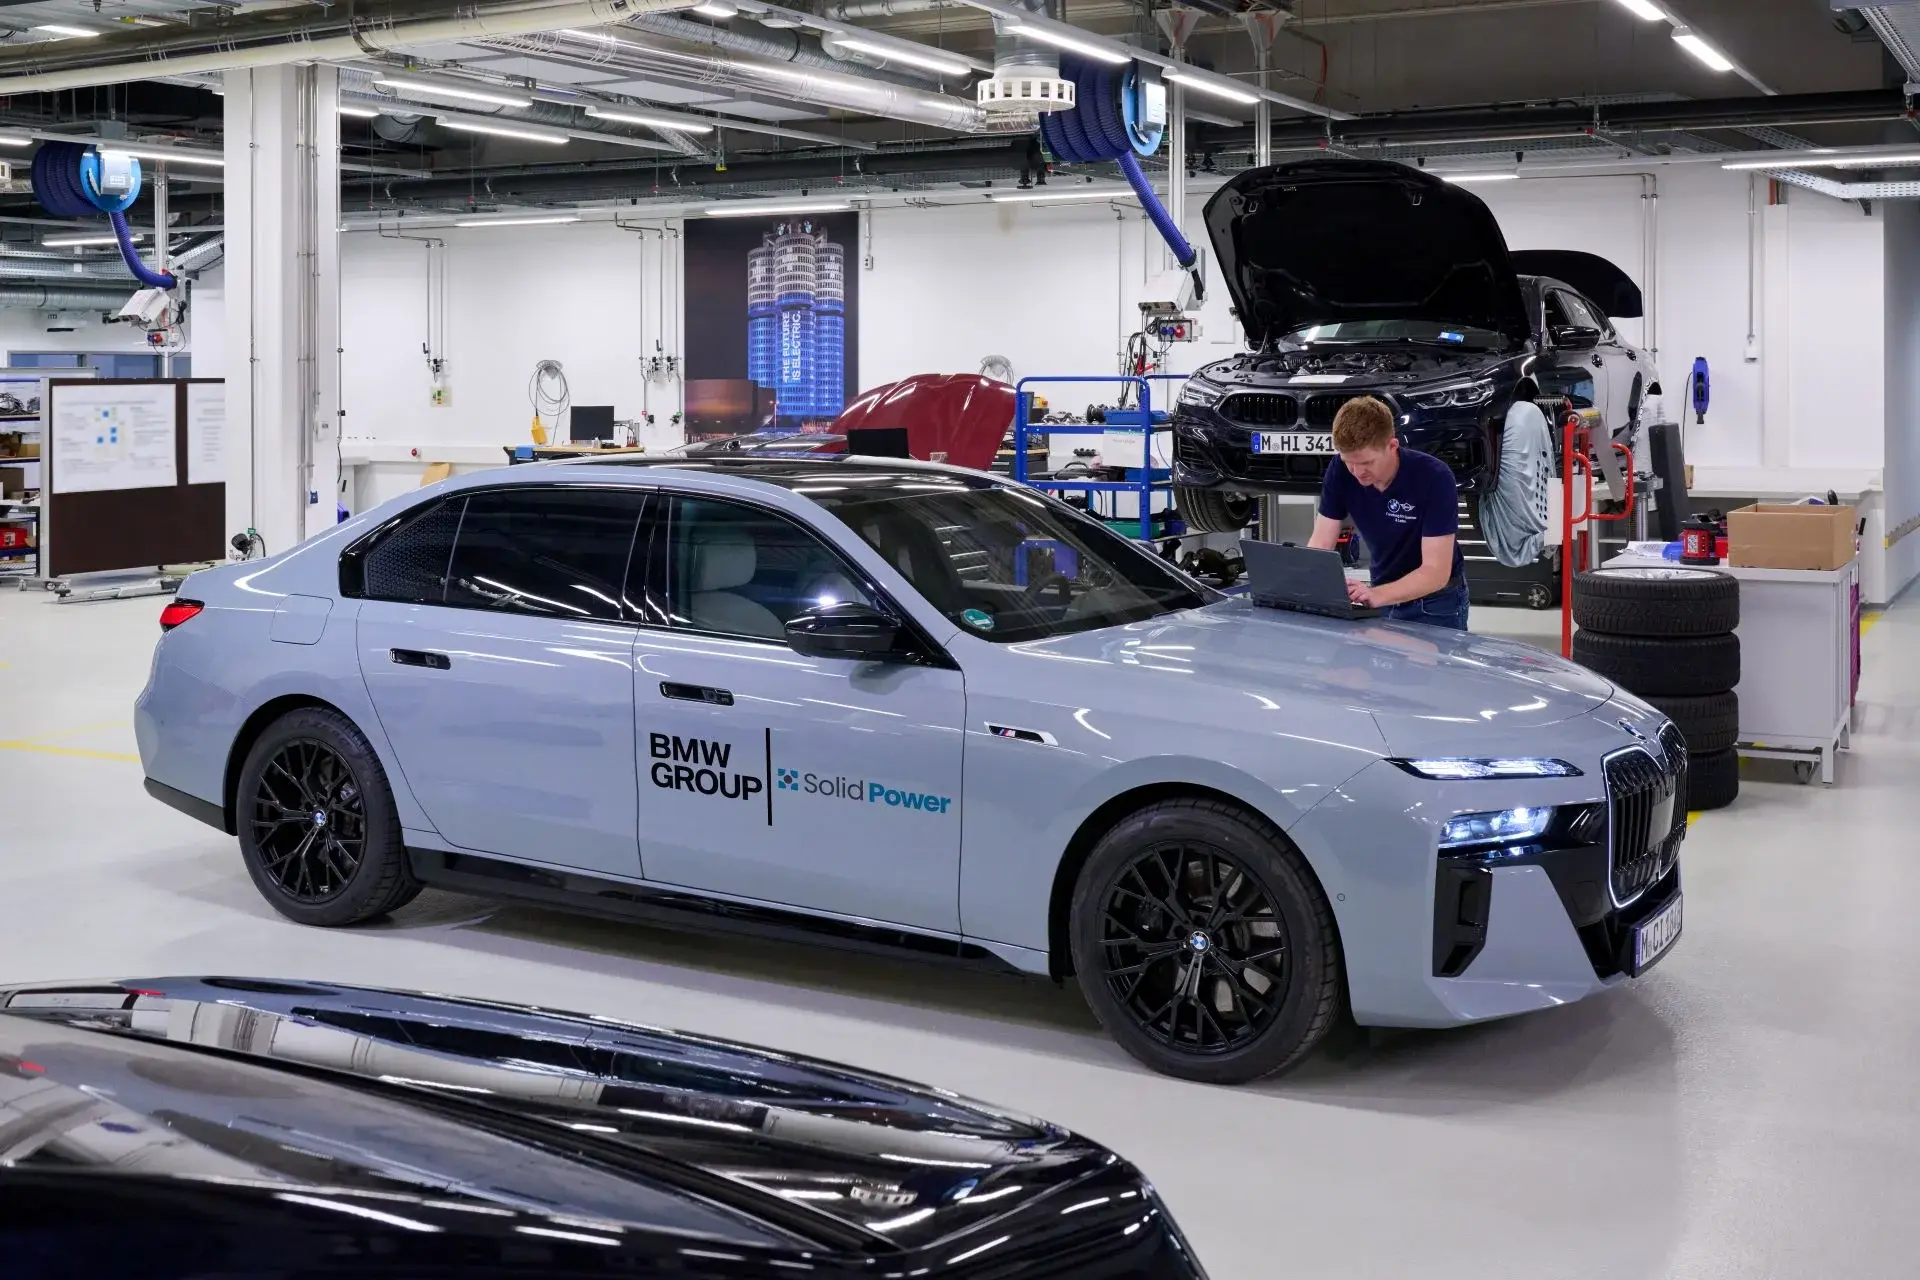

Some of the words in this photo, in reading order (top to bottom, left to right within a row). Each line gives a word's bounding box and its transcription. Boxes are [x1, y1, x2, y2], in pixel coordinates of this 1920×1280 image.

[782, 311, 790, 357] FUTURE
[782, 359, 790, 384] THE
[792, 370, 801, 381] IS
[1261, 435, 1271, 451] M
[1281, 435, 1300, 451] HI
[650, 732, 731, 768] BMW
[650, 762, 762, 800] GROUP
[804, 773, 864, 801] Solid
[869, 783, 951, 813] Power
